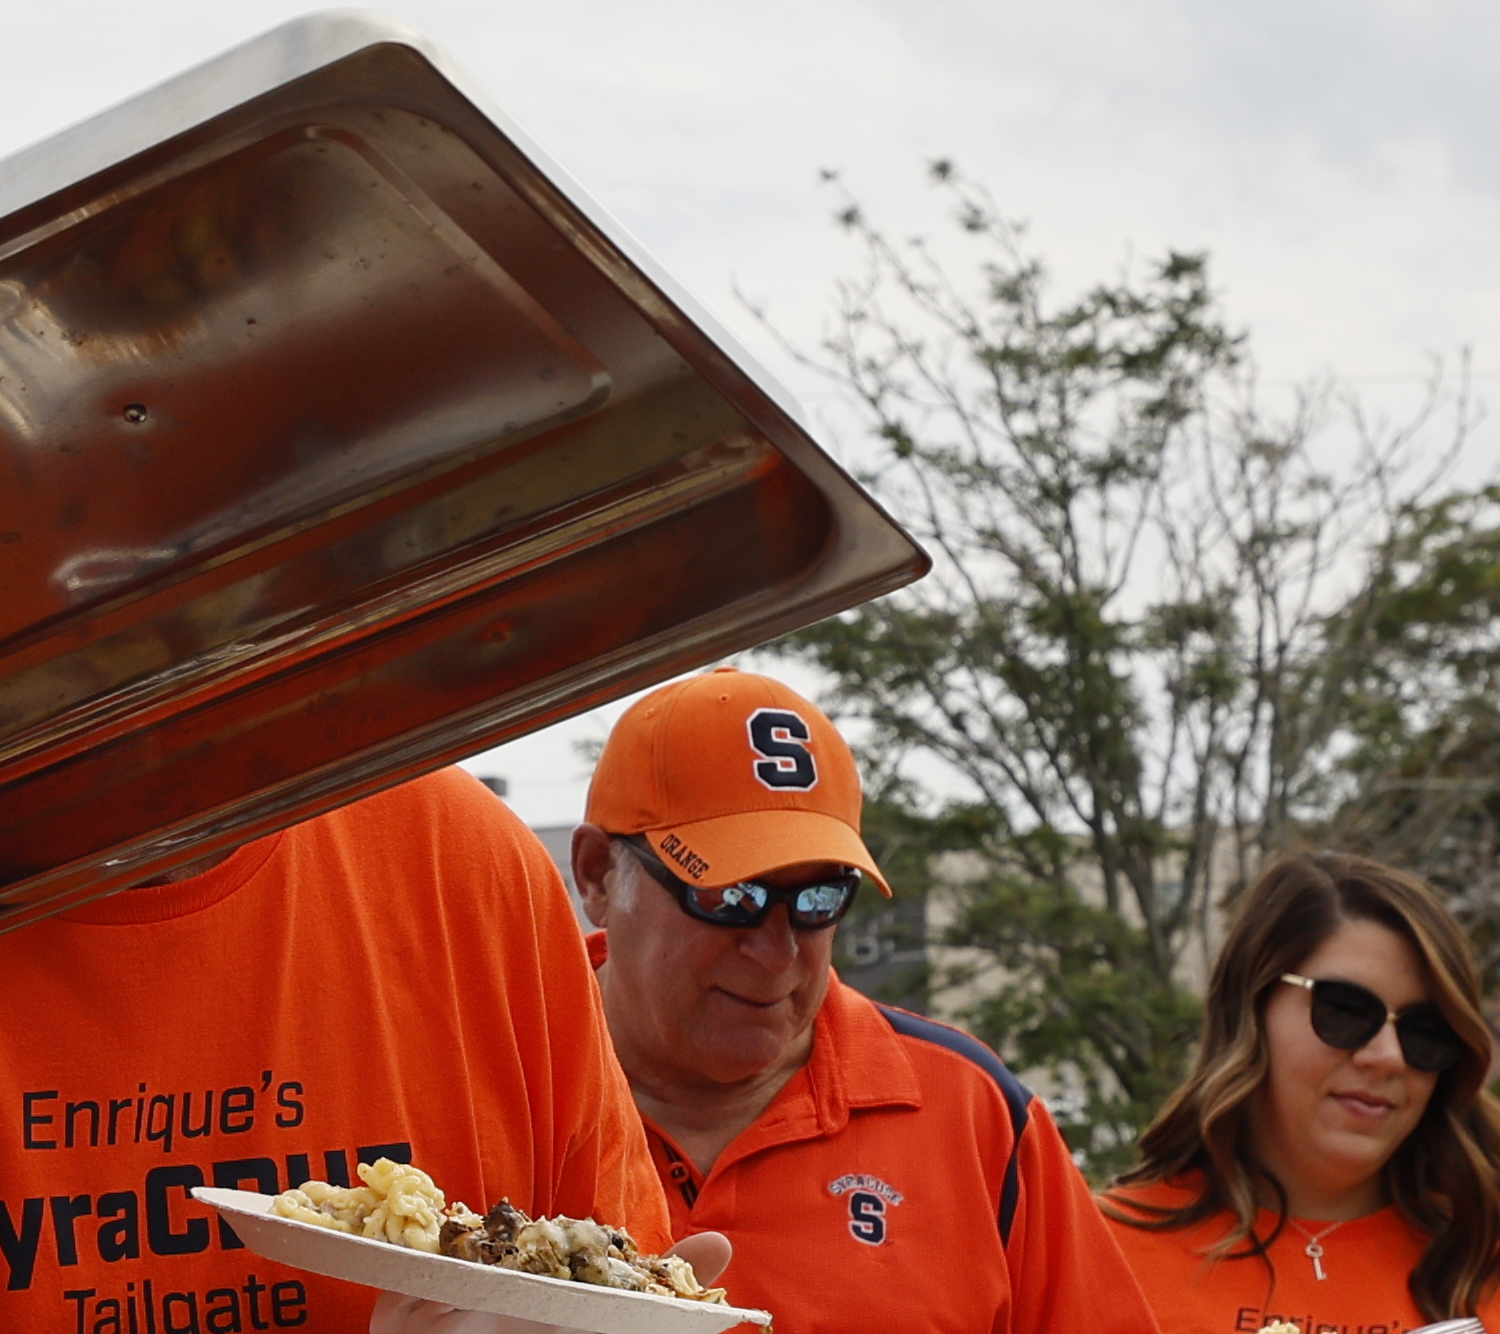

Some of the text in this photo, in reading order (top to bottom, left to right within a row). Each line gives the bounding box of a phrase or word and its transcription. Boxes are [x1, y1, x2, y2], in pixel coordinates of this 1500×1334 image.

[745, 707, 818, 792] S
[660, 833, 710, 880] ORANGE
[22, 1070, 306, 1153] Enrique's
[827, 1173, 904, 1207] SYRACUSE
[848, 1188, 887, 1247] S
